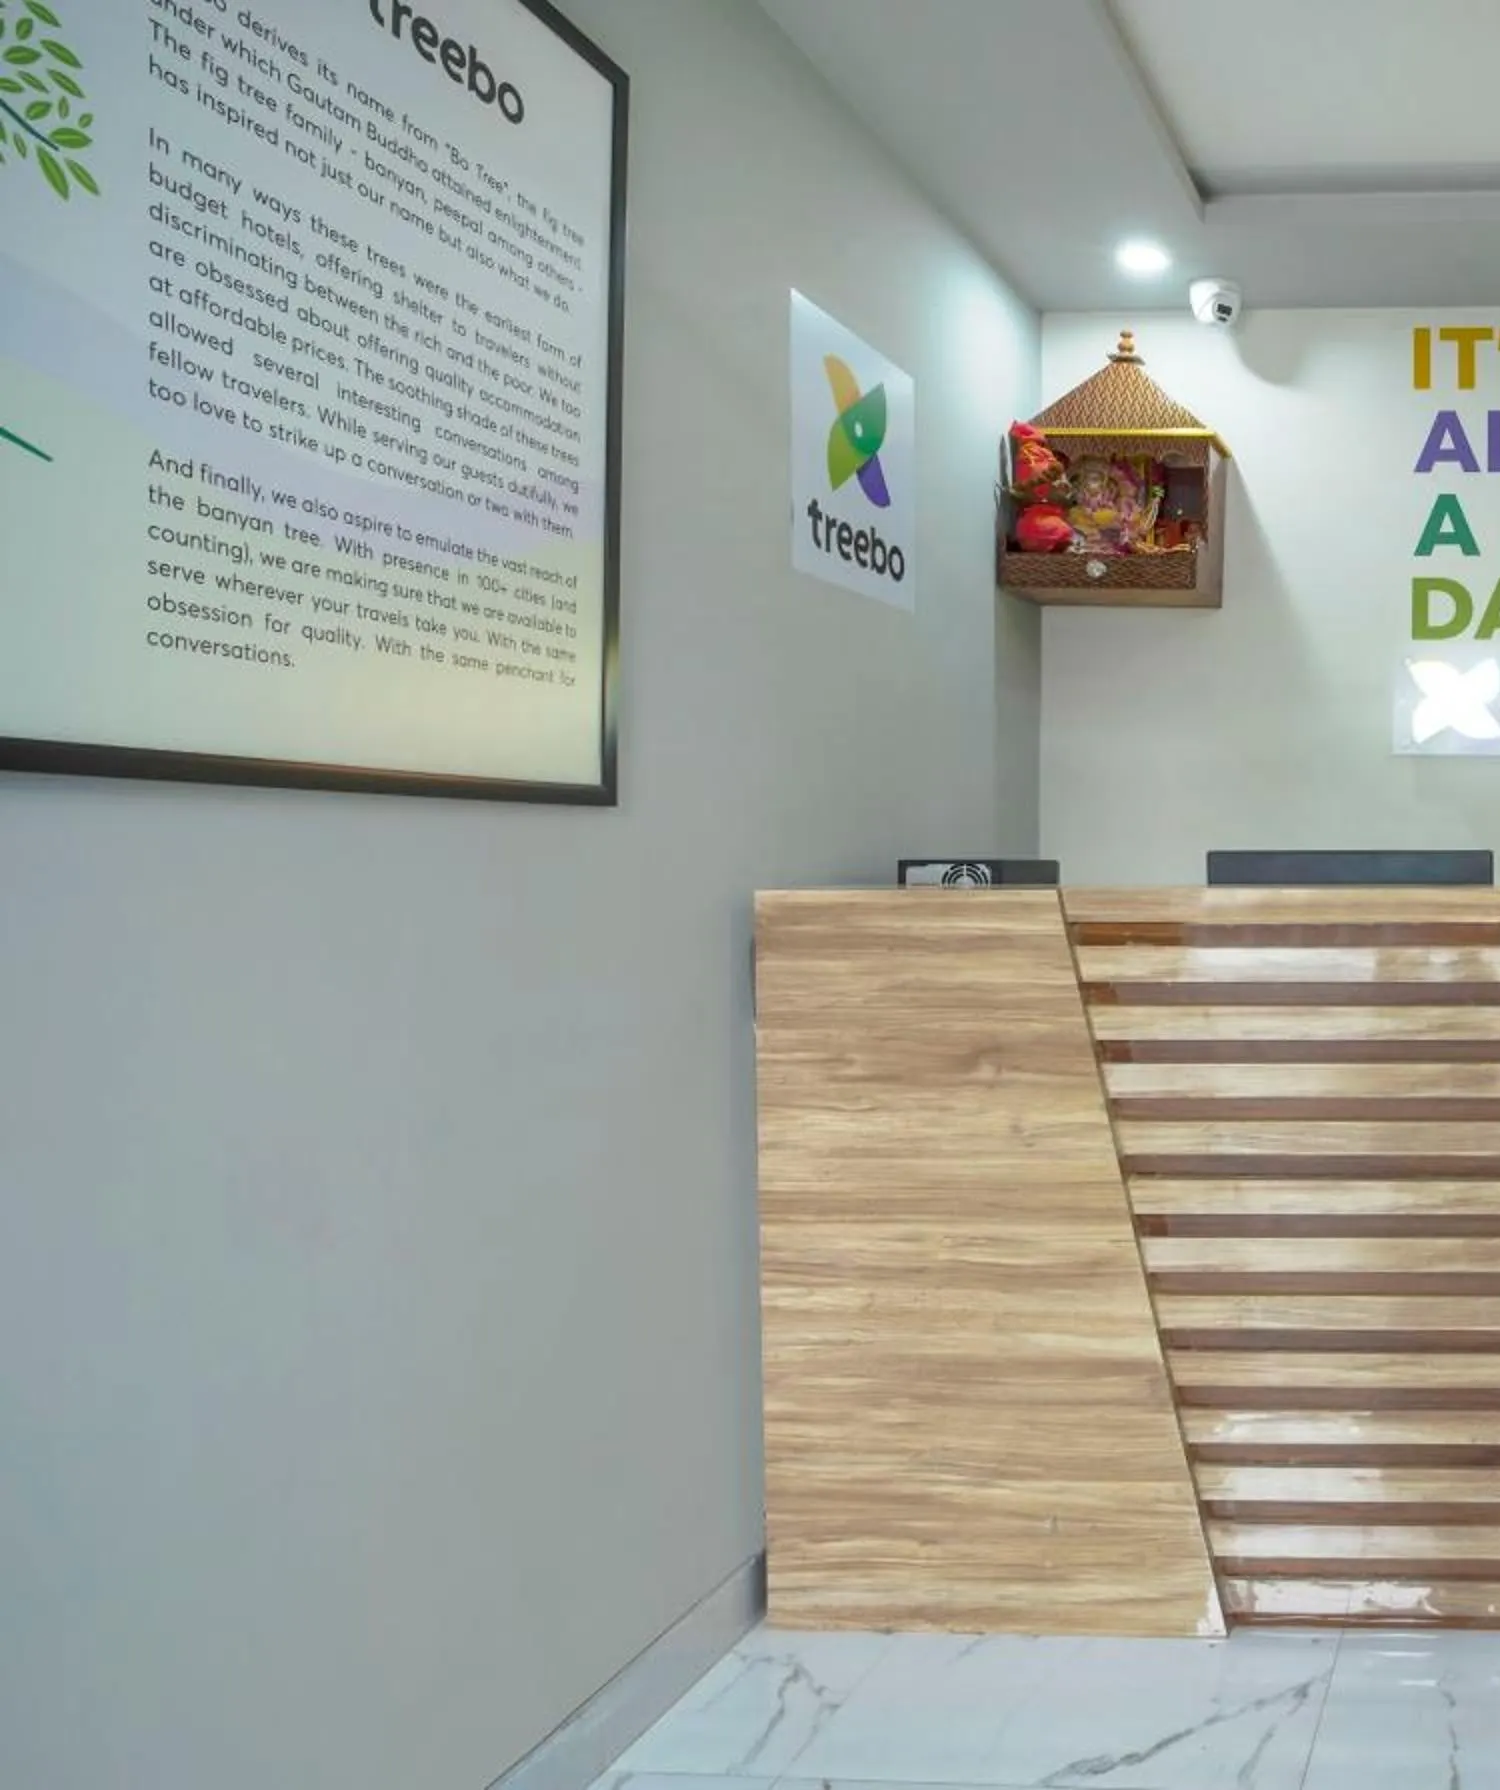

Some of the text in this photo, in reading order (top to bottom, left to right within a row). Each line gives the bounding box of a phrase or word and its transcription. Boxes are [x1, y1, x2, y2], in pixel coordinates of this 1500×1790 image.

[148, 19, 190, 60] The
[201, 50, 228, 86] fig
[237, 71, 277, 110] tree
[285, 100, 342, 153] family
[221, 33, 280, 80] which
[286, 69, 360, 128] Gautam
[366, 119, 428, 170] Buddha
[237, 4, 308, 64] derives
[317, 55, 337, 83] its
[347, 79, 394, 119] name
[402, 110, 437, 146] from
[149, 56, 189, 94] has
[196, 82, 278, 145] inspired
[285, 138, 315, 166] not
[319, 153, 352, 188] just
[357, 179, 384, 205] our
[390, 198, 434, 233] name
[149, 127, 169, 155] In
[182, 151, 241, 196] many
[253, 187, 300, 222] ways
[310, 212, 357, 252] these
[367, 241, 405, 276] trees
[413, 270, 448, 298] were
[149, 165, 227, 220] budget
[241, 210, 304, 262] hotels,
[315, 251, 382, 298] offering
[393, 289, 442, 324] shelter
[148, 200, 297, 290] discriminating
[304, 274, 378, 323] between
[384, 310, 408, 337] the
[414, 327, 441, 352] rich
[149, 241, 184, 269] are
[195, 261, 288, 314] obsessed
[297, 306, 349, 341] about
[357, 333, 418, 374] offering
[425, 363, 473, 398] quality
[148, 277, 172, 299] at
[179, 289, 286, 345] affordable
[354, 358, 384, 385] The
[388, 376, 453, 417] soothing
[148, 343, 213, 383] fellow
[317, 406, 366, 439] While
[372, 430, 427, 464] serving
[149, 312, 233, 357] allowed
[253, 353, 318, 391] several
[337, 382, 420, 433] interesting
[148, 379, 186, 409] too
[193, 394, 235, 426] love
[242, 411, 262, 434] to
[269, 424, 318, 453] strike
[324, 443, 345, 466] up
[351, 452, 362, 467] a
[367, 458, 463, 501] conversation
[148, 450, 193, 480] And
[200, 465, 264, 505] finally,
[271, 490, 296, 509] we
[343, 511, 392, 536] aspire
[396, 522, 412, 542] to
[415, 531, 473, 559] emulate
[148, 485, 184, 512] the
[197, 498, 272, 535] banyan
[334, 536, 372, 561] With
[383, 551, 449, 580] presence
[808, 498, 905, 582] treebo
[1414, 494, 1481, 557] A
[147, 525, 252, 567] counting),
[259, 552, 286, 570] we
[291, 559, 320, 578] are
[326, 568, 388, 598] making
[392, 583, 422, 602] sure
[427, 588, 456, 610] that
[147, 560, 204, 586] serve
[215, 575, 303, 606] wherever
[311, 595, 349, 616] your
[356, 601, 408, 627] travels
[415, 613, 446, 635] take
[147, 593, 252, 628] obsession
[264, 613, 290, 635] for
[375, 635, 410, 656] With
[420, 643, 444, 662] the
[146, 630, 296, 667] conversations.
